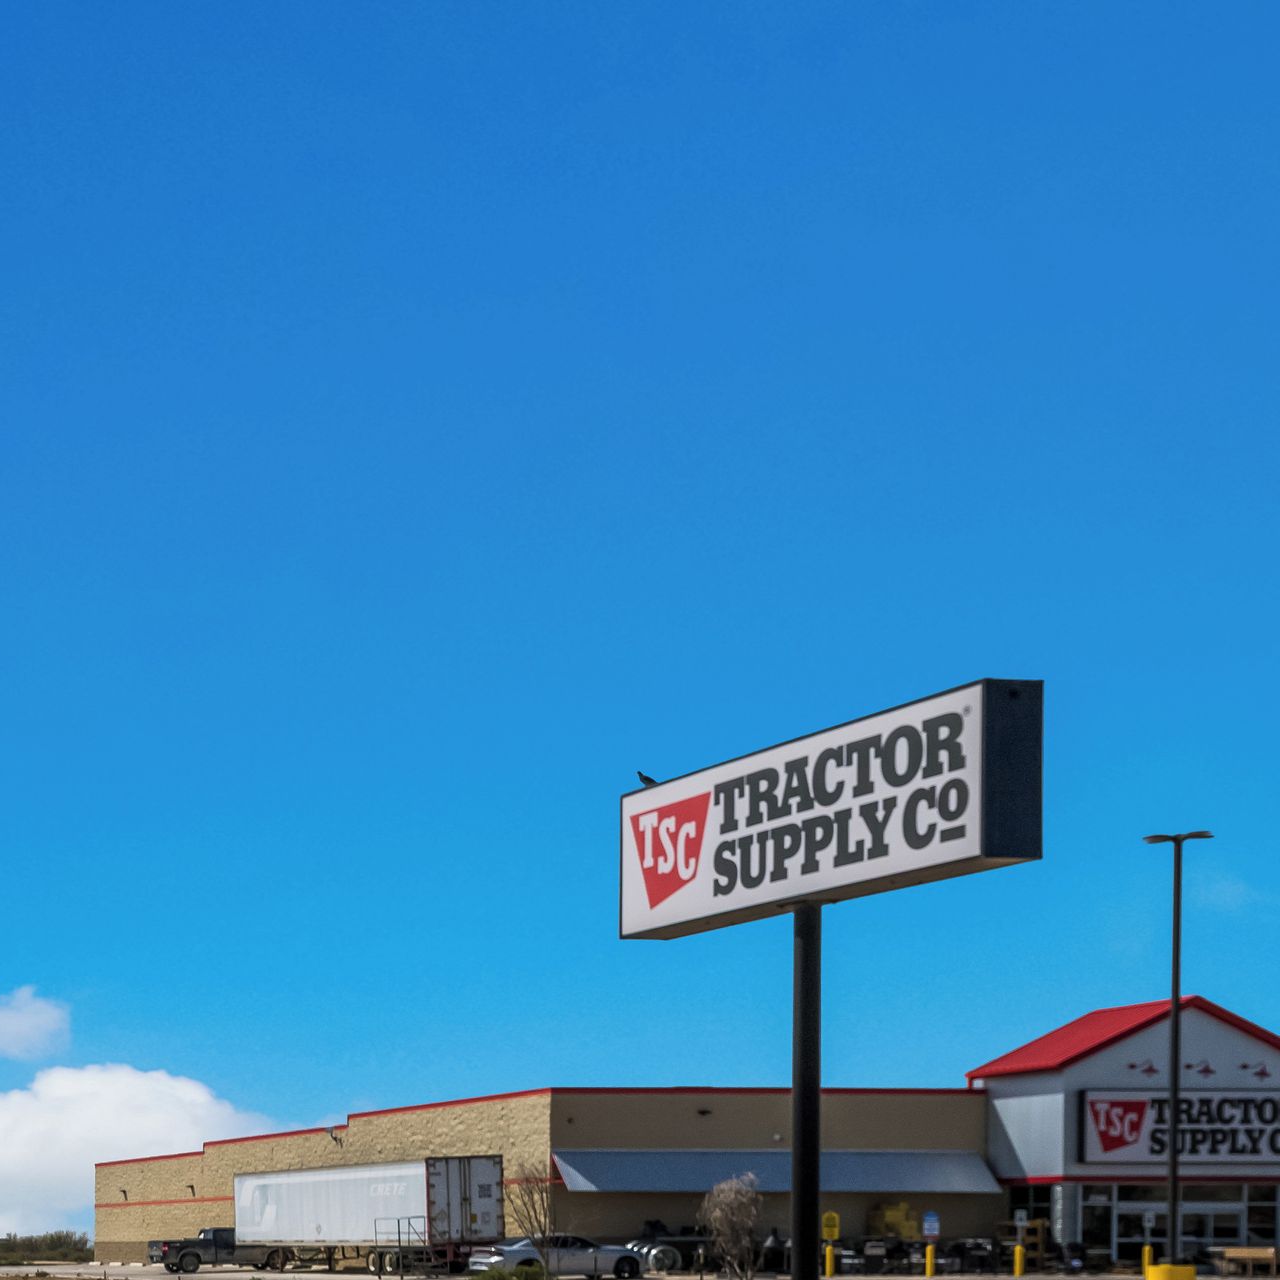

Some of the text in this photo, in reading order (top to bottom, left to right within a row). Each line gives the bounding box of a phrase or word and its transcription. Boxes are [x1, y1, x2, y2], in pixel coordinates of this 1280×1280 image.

[713, 713, 967, 835] TRACTOR
[638, 811, 697, 881] TSC
[713, 796, 898, 897] SUPPLY
[1093, 1102, 1139, 1142] TSC
[1151, 1098, 1280, 1125] TRACTO
[1150, 1128, 1266, 1155] SUPPLY
[370, 1183, 407, 1196] CRETE
